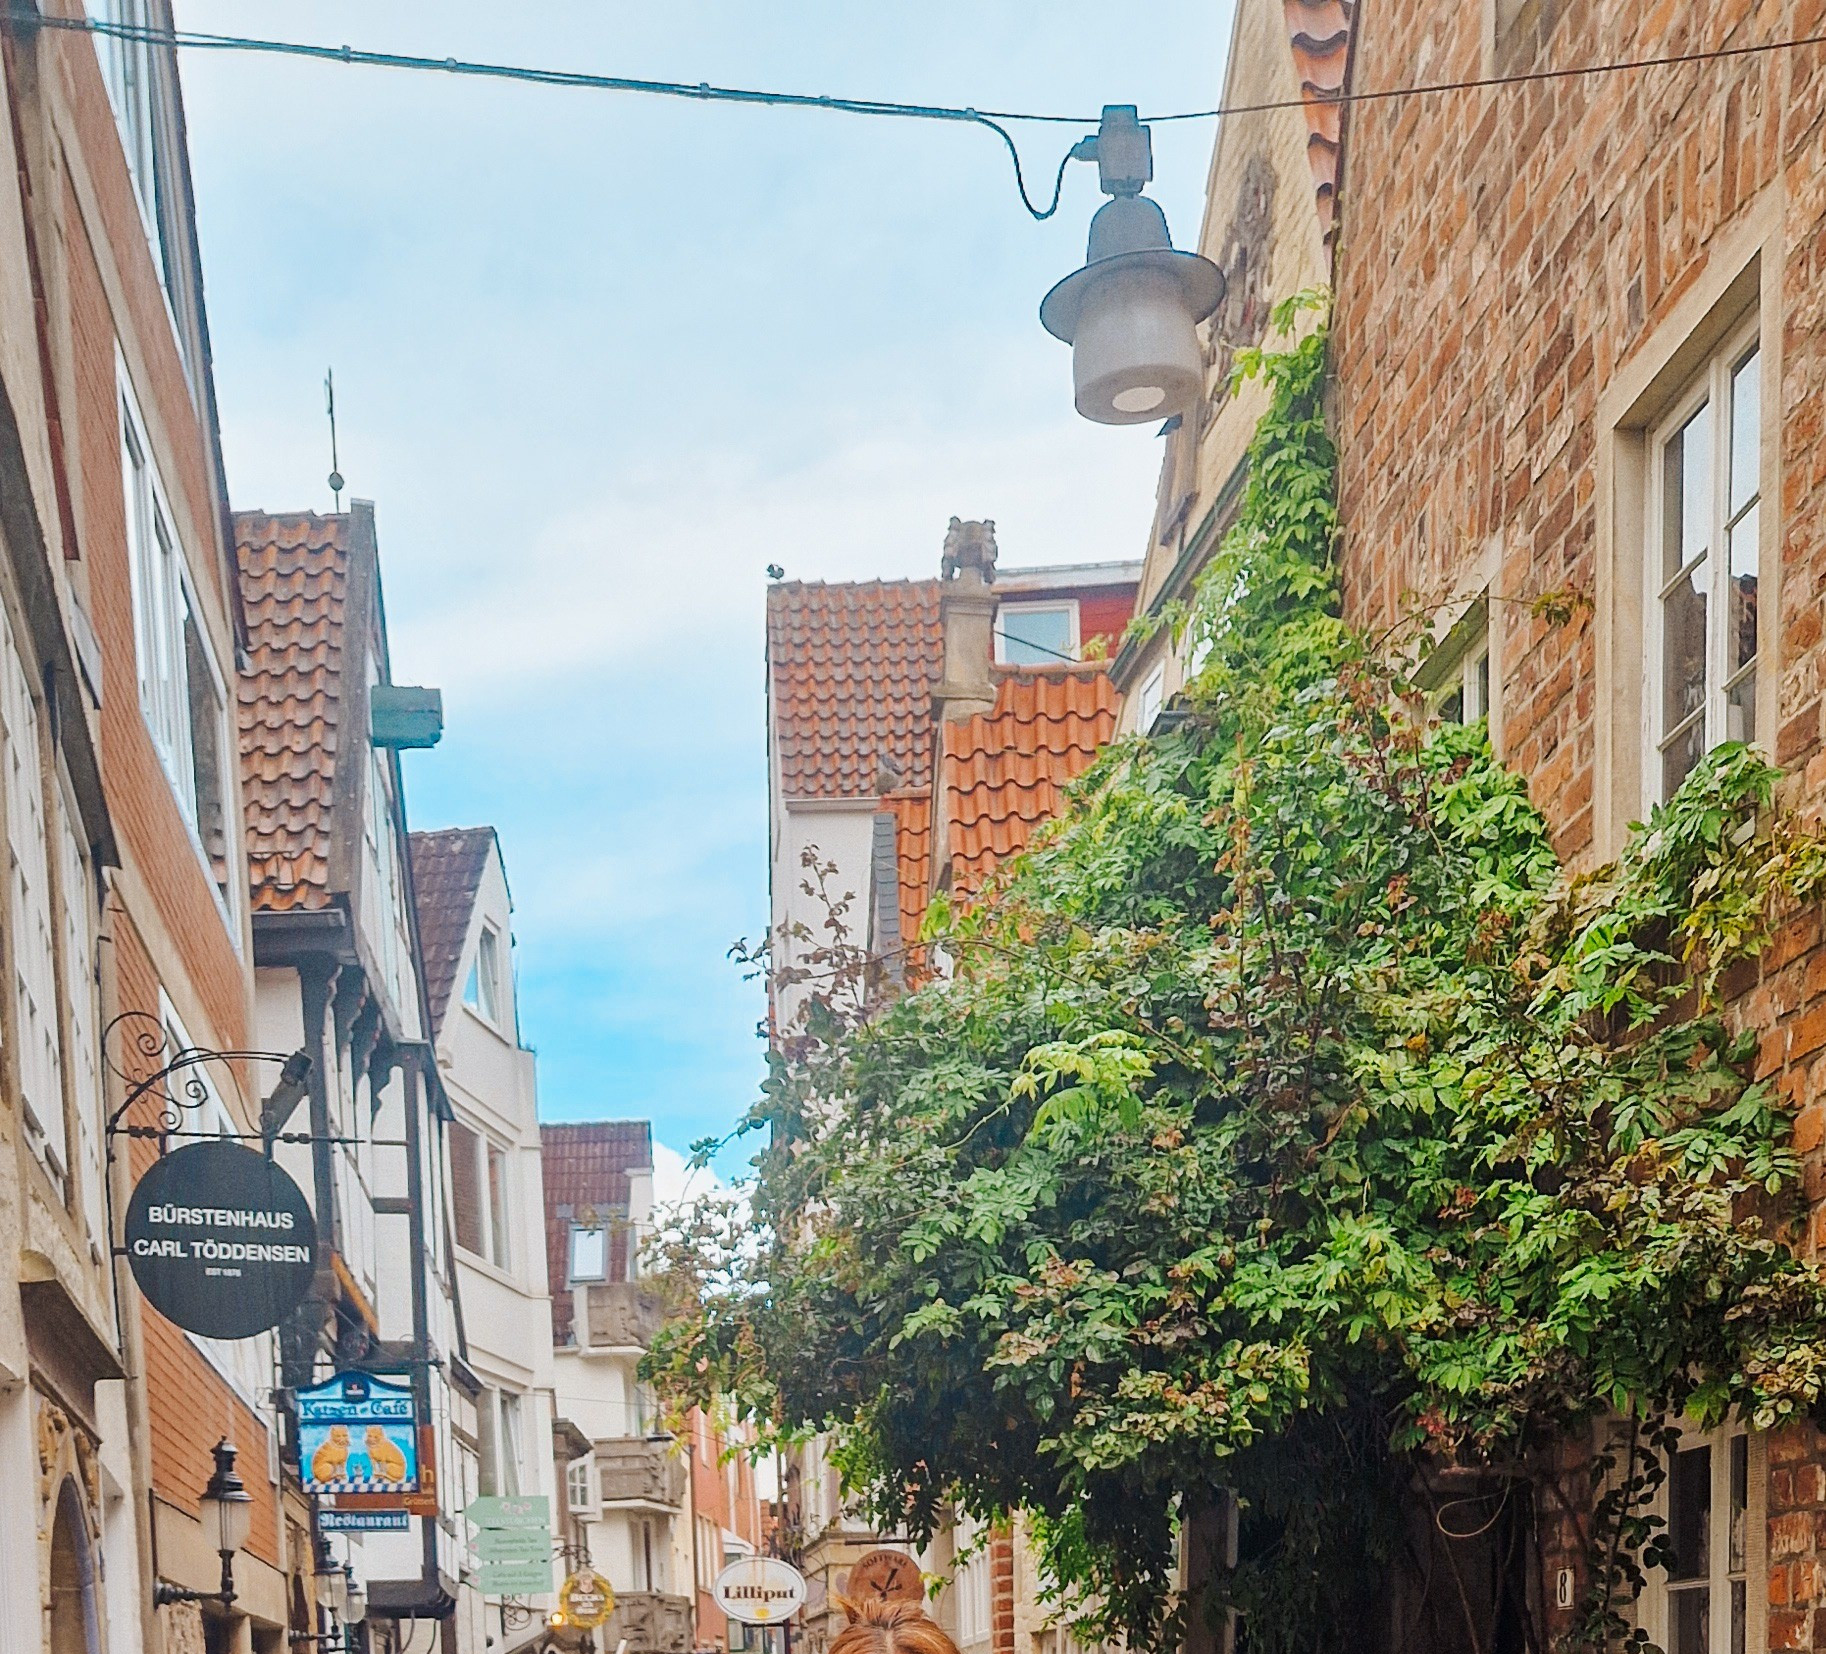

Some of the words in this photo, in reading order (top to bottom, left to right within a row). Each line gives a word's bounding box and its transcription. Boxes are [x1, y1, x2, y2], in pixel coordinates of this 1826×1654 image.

[148, 1203, 294, 1229] BÜRSTENHAUS
[133, 1238, 188, 1258] CARL
[190, 1239, 310, 1263] TÖDDENSEN
[319, 1511, 408, 1527] Restaurant
[723, 1585, 795, 1603] Lilliput
[1559, 1571, 1568, 1604] 8
